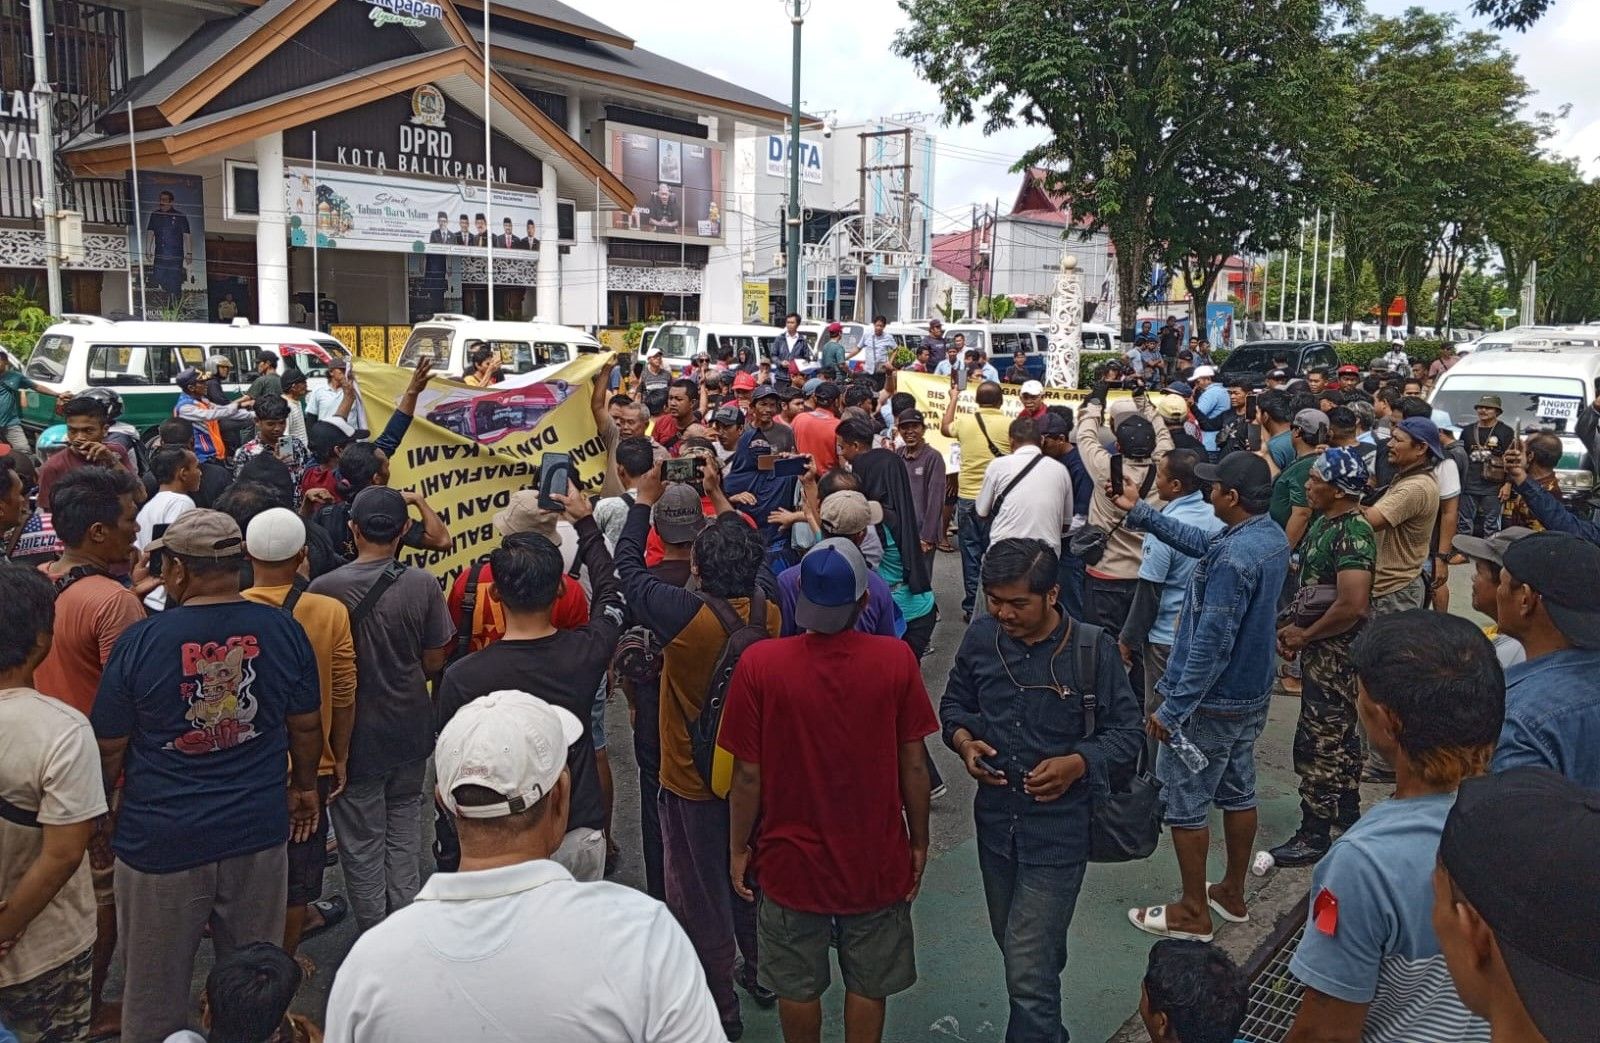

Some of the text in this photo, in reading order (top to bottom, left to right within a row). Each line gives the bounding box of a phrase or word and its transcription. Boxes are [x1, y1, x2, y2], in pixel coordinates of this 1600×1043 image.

[0, 129, 41, 160] YAT
[400, 124, 452, 158] DPRD
[338, 146, 507, 183] KOTA BALIKPAPAN
[356, 203, 429, 219] Tahun Baru Islam
[927, 390, 946, 400] BIS
[929, 401, 975, 415] BIS ME
[1041, 391, 1061, 400] RA
[1063, 393, 1087, 402] GA
[1540, 400, 1579, 410] ANGKOT
[1544, 408, 1571, 417] DEMO
[516, 425, 559, 458] DAN
[568, 436, 606, 465] IDA
[407, 442, 480, 469] KAMI
[457, 490, 510, 520] DAN
[15, 534, 56, 551] SHIELD
[404, 522, 493, 569] BALIKPAP
